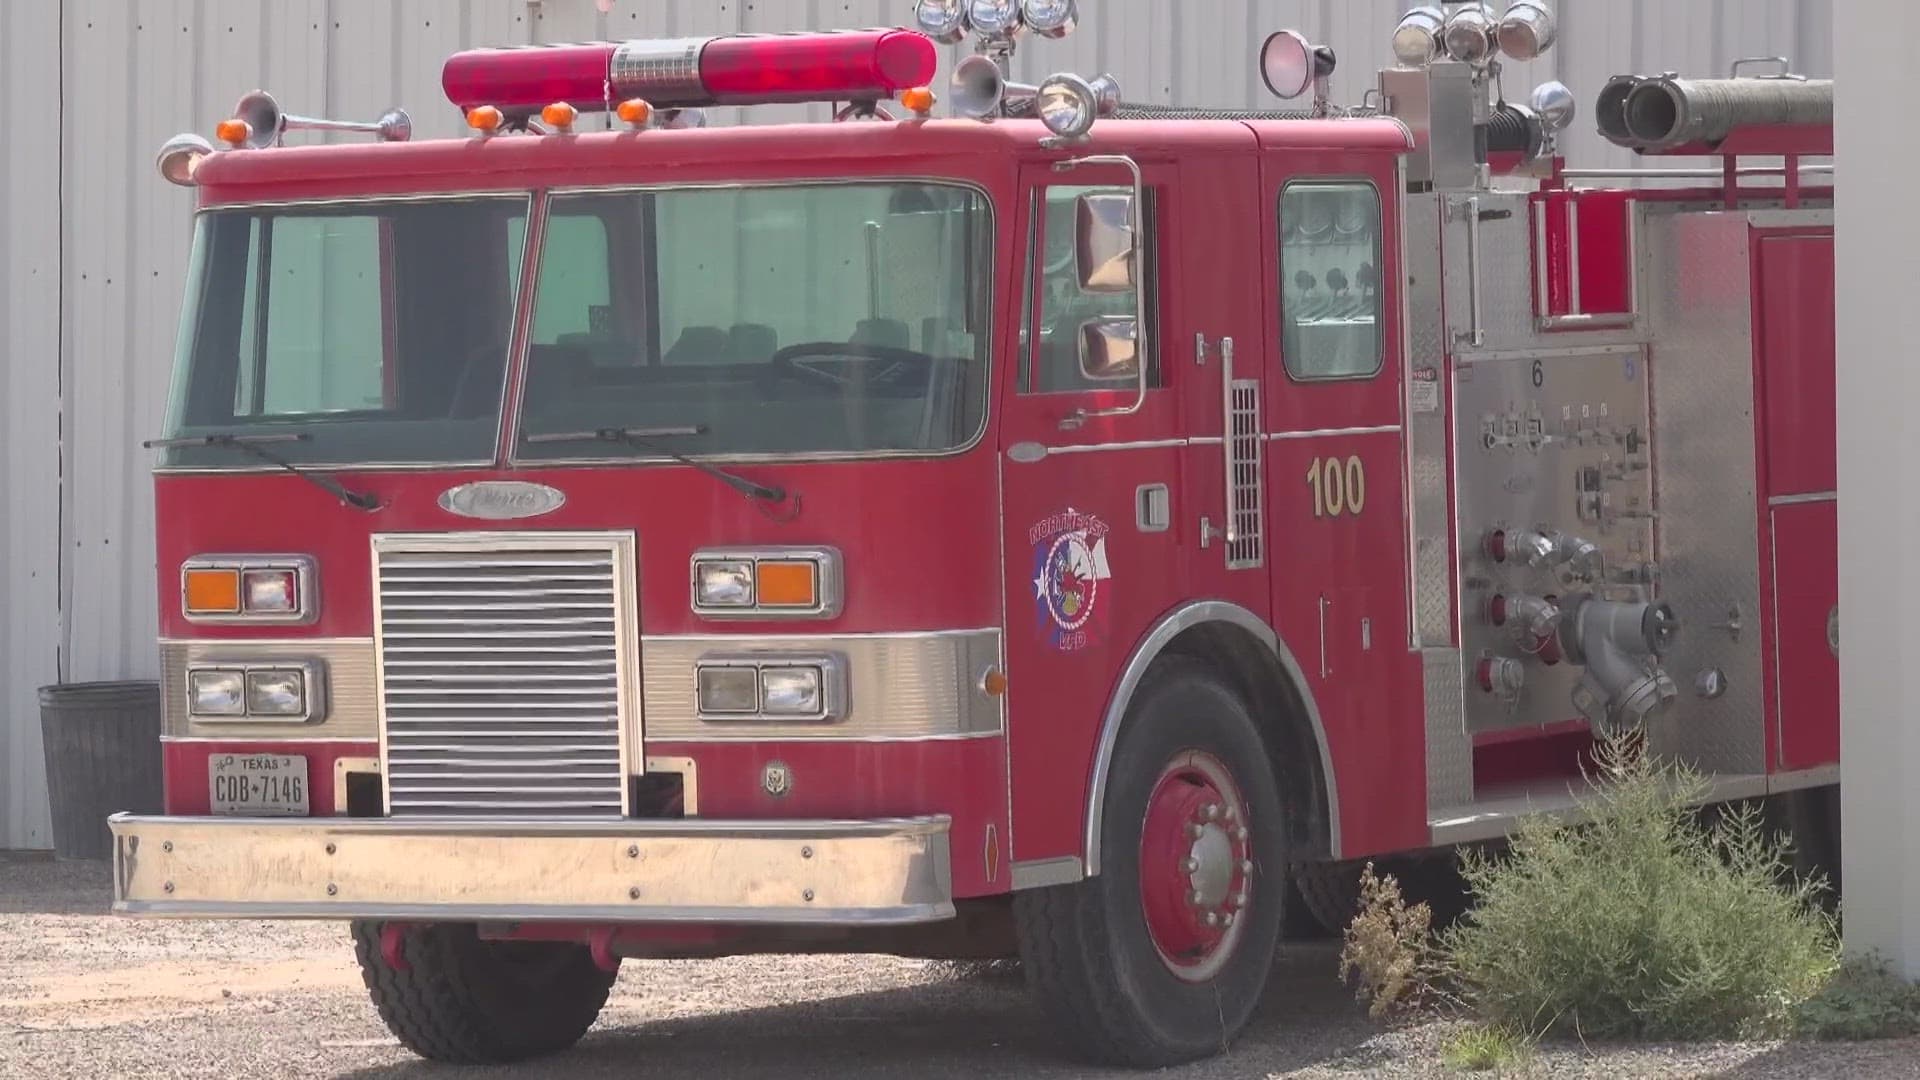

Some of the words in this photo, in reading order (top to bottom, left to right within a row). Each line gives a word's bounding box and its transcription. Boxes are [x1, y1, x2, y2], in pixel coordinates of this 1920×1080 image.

[1531, 360, 1543, 387] 6
[1306, 455, 1365, 516] 100
[1029, 512, 1109, 545] NORTHEAST
[241, 758, 279, 770] TEXAS
